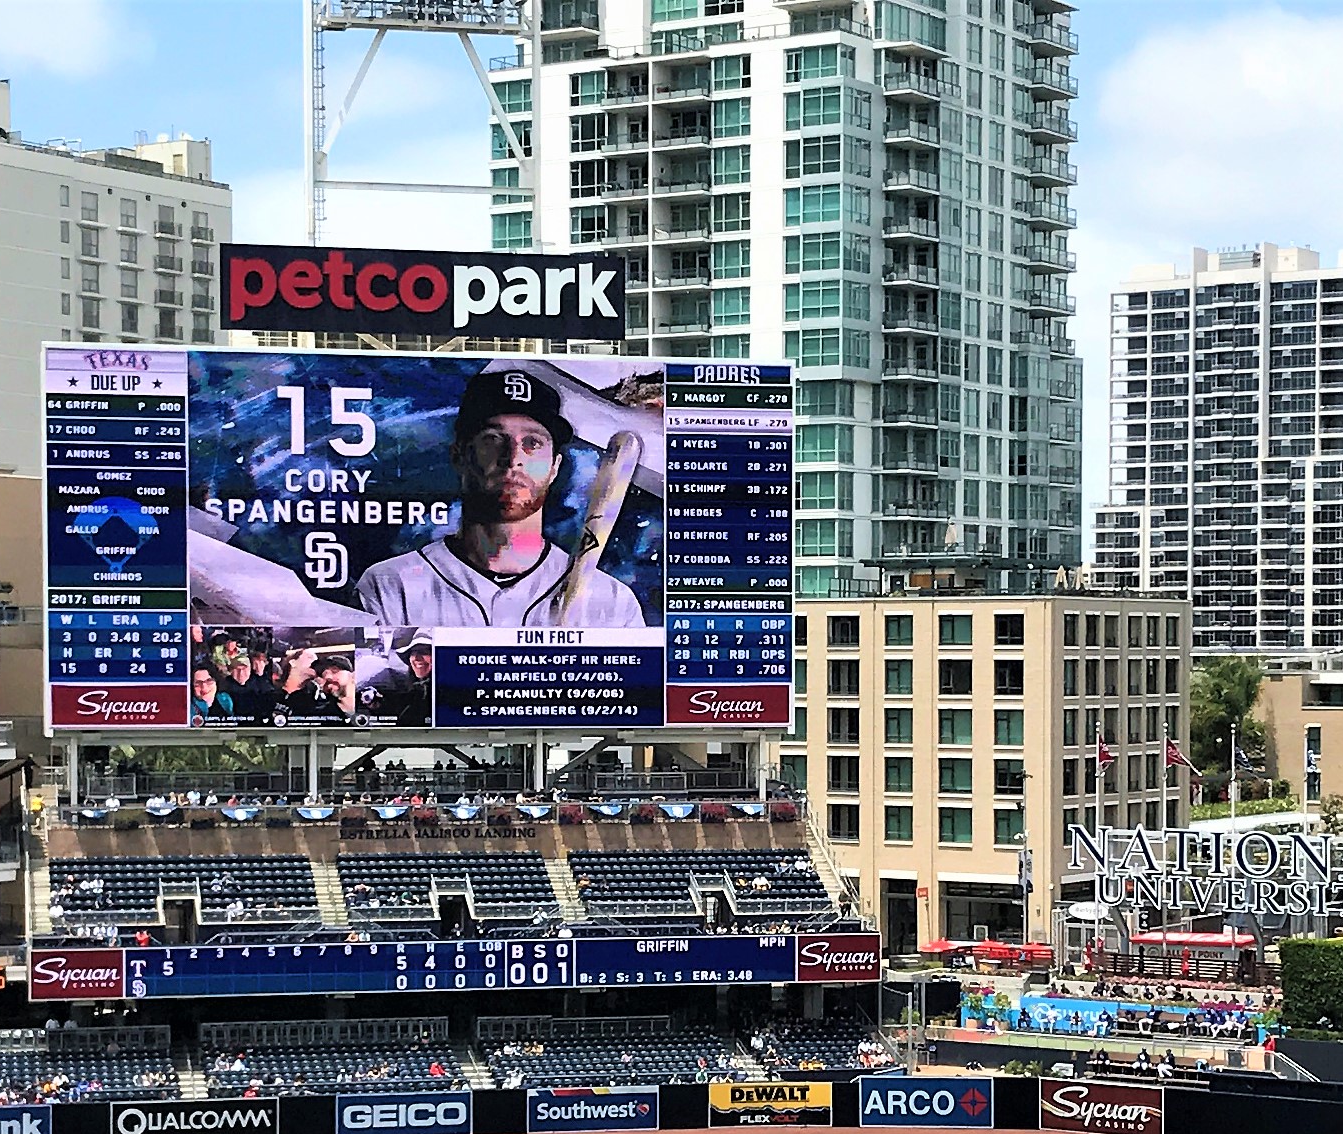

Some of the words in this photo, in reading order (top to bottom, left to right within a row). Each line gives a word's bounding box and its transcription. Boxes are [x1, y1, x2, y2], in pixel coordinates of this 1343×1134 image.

[84, 350, 152, 370] TEXAS
[694, 366, 760, 385] PADRES
[91, 375, 117, 391] DUE
[122, 375, 141, 391] UP
[684, 393, 726, 403] MARGOT
[47, 401, 62, 409] 64
[66, 401, 109, 410] GRIFFIN
[276, 385, 376, 457] 15
[65, 426, 96, 435] CHOO
[683, 440, 717, 449] MYERS
[65, 450, 110, 459] ANDRUS
[683, 462, 728, 471] SOLARTE
[96, 471, 132, 480] GOMEZ
[285, 469, 372, 493] CORY
[59, 486, 100, 495] MAZARA
[137, 487, 166, 495] CHOO
[683, 484, 726, 493] SCHIMPF
[66, 505, 109, 513] ANDRUS
[140, 506, 169, 515] ODOR
[205, 499, 449, 525] SPANGENBERG
[683, 508, 723, 517] HEDGES
[65, 525, 99, 534] GALLO
[138, 526, 160, 535] RUA
[683, 531, 729, 540] RENFROE
[95, 546, 137, 555] GRIFFIN
[93, 572, 143, 581] CHIRINOS
[682, 577, 724, 586] WEAVER
[51, 594, 87, 605] 2017:
[92, 595, 141, 605] GRIFFIN
[668, 600, 701, 609] 2017:
[703, 600, 785, 610] SPANGENBERG
[517, 631, 544, 644] FUN
[550, 631, 584, 644] FACT
[458, 655, 507, 665] ROOKIE
[511, 655, 577, 665] WALK-OFF
[582, 655, 599, 665] HR
[603, 655, 641, 665] HERE:
[494, 671, 557, 681] BARFIELD
[494, 689, 563, 699] MCANULTY
[77, 690, 160, 721] Sycuan
[689, 690, 765, 719] Sycuan
[463, 706, 477, 716] C.
[481, 706, 576, 716] SPANGENBERG
[581, 706, 638, 716] (9/2/14)
[414, 827, 471, 839] JALISCO
[475, 827, 536, 839] LANDING
[479, 941, 503, 951] LOB
[636, 939, 689, 952] GRIFFIN
[759, 936, 786, 947] MPH
[800, 941, 877, 971] Sycuan
[1198, 950, 1224, 959] POINT
[33, 957, 120, 989] Sycuan
[130, 960, 147, 978] T
[692, 972, 722, 981] ERA:
[864, 1090, 955, 1116] ARCO
[1053, 1086, 1152, 1127] Sycuan
[537, 1099, 638, 1120] Southwest
[343, 1101, 468, 1129] GEICO
[1095, 1119, 1144, 1131] CASINO
